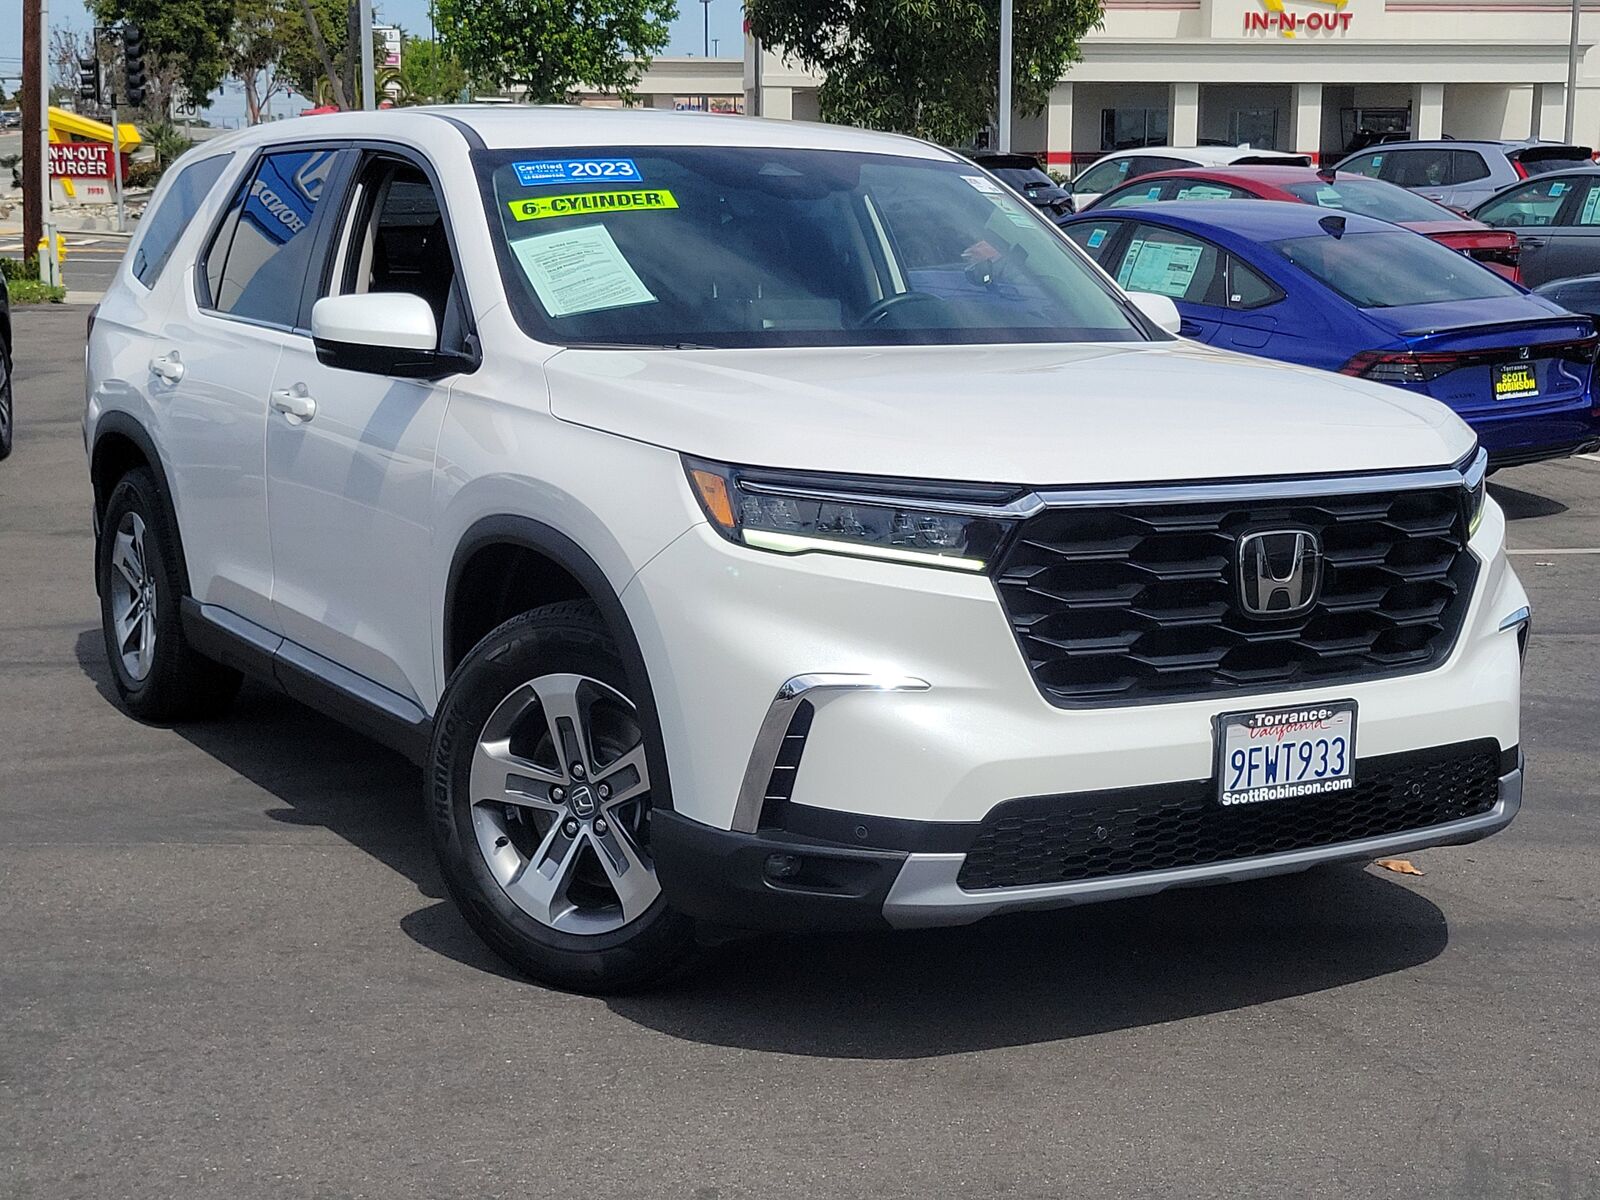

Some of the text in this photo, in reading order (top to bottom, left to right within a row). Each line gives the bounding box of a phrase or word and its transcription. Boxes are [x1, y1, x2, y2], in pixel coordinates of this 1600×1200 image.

[1245, 12, 1353, 30] IN-N-OUT
[48, 146, 108, 161] N-N-OUT
[568, 162, 634, 177] 2023
[522, 193, 664, 215] 6-CYLINDER
[1496, 378, 1536, 393] ROBINSON
[1502, 371, 1527, 383] SCOTT
[1255, 710, 1327, 727] Torrance
[1229, 736, 1346, 790] 9FWT933
[1222, 778, 1352, 806] ScottRobinson.com
